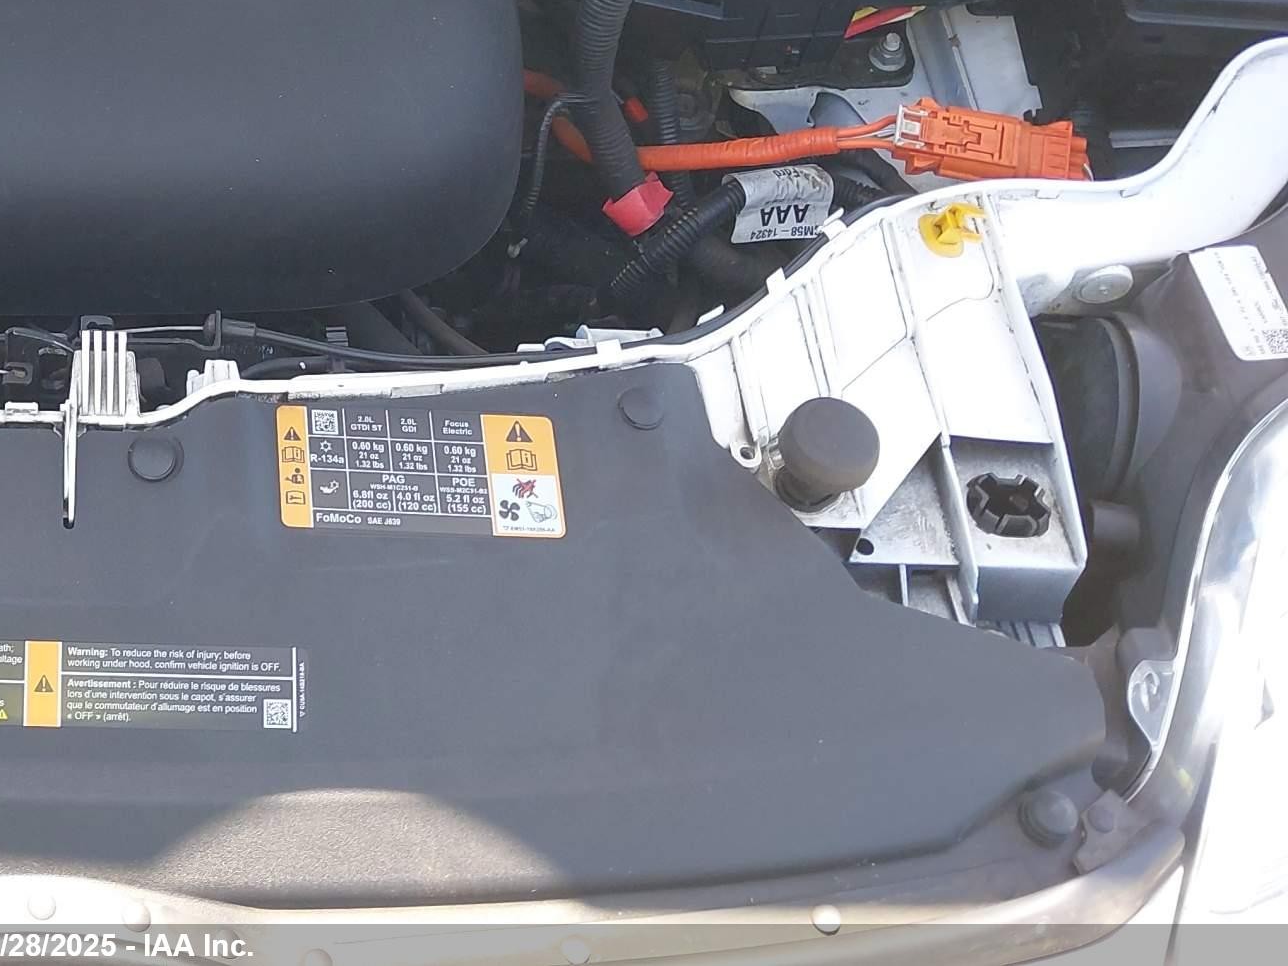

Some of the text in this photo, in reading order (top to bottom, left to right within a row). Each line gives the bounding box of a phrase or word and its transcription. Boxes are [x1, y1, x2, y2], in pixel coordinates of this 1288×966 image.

[759, 203, 810, 227] AAA
[750, 228, 778, 241] 14324
[371, 424, 383, 432] ST
[402, 425, 417, 433] GDI
[444, 420, 469, 428] Focus
[442, 427, 473, 435] Electric
[352, 441, 385, 453] 0.60 kg
[395, 443, 428, 455] 0.60 kg
[444, 445, 476, 458] 0.60 kg
[311, 454, 345, 464] R-134a
[402, 453, 412, 461] 21
[355, 460, 385, 469] 1.32 lbs
[398, 462, 414, 470] 1.32
[447, 465, 477, 473] 1.32 lbs
[382, 474, 406, 484] PAG
[452, 477, 476, 487] POE
[376, 492, 389, 500] oz
[396, 492, 435, 502] 4.0 fl oz
[446, 494, 485, 504] 5.2 fl oz
[353, 499, 392, 510] (200 cc)
[398, 501, 437, 513] (120 cc)
[447, 504, 487, 514] (155 cc)
[316, 513, 362, 524] FoMoCo
[67, 647, 108, 658] Warning:
[110, 648, 120, 657] To
[122, 648, 151, 657] reduce
[153, 649, 167, 658] the
[169, 650, 184, 658] risk
[185, 650, 195, 659] of
[223, 651, 251, 660] before
[67, 659, 101, 669] working
[102, 659, 128, 668] under
[154, 660, 186, 669] confirm
[187, 661, 218, 670] vehicle
[219, 662, 250, 672] ignition
[251, 662, 259, 671] is
[260, 663, 281, 672] OFF.
[67, 679, 131, 688] Avertissement
[138, 680, 158, 689] Pour
[159, 681, 189, 689] réduire
[191, 682, 198, 690] le
[200, 682, 226, 692] risque
[228, 683, 238, 691] de
[240, 683, 281, 692] blessures
[67, 690, 83, 698] lors
[109, 691, 158, 700] intervention
[159, 692, 179, 701] sous
[181, 692, 189, 701] le
[190, 694, 216, 702] capot,
[67, 702, 83, 710] que
[84, 701, 93, 709] le
[94, 702, 149, 711] commutateur
[224, 705, 257, 714] position
[74, 711, 93, 720] OFF
